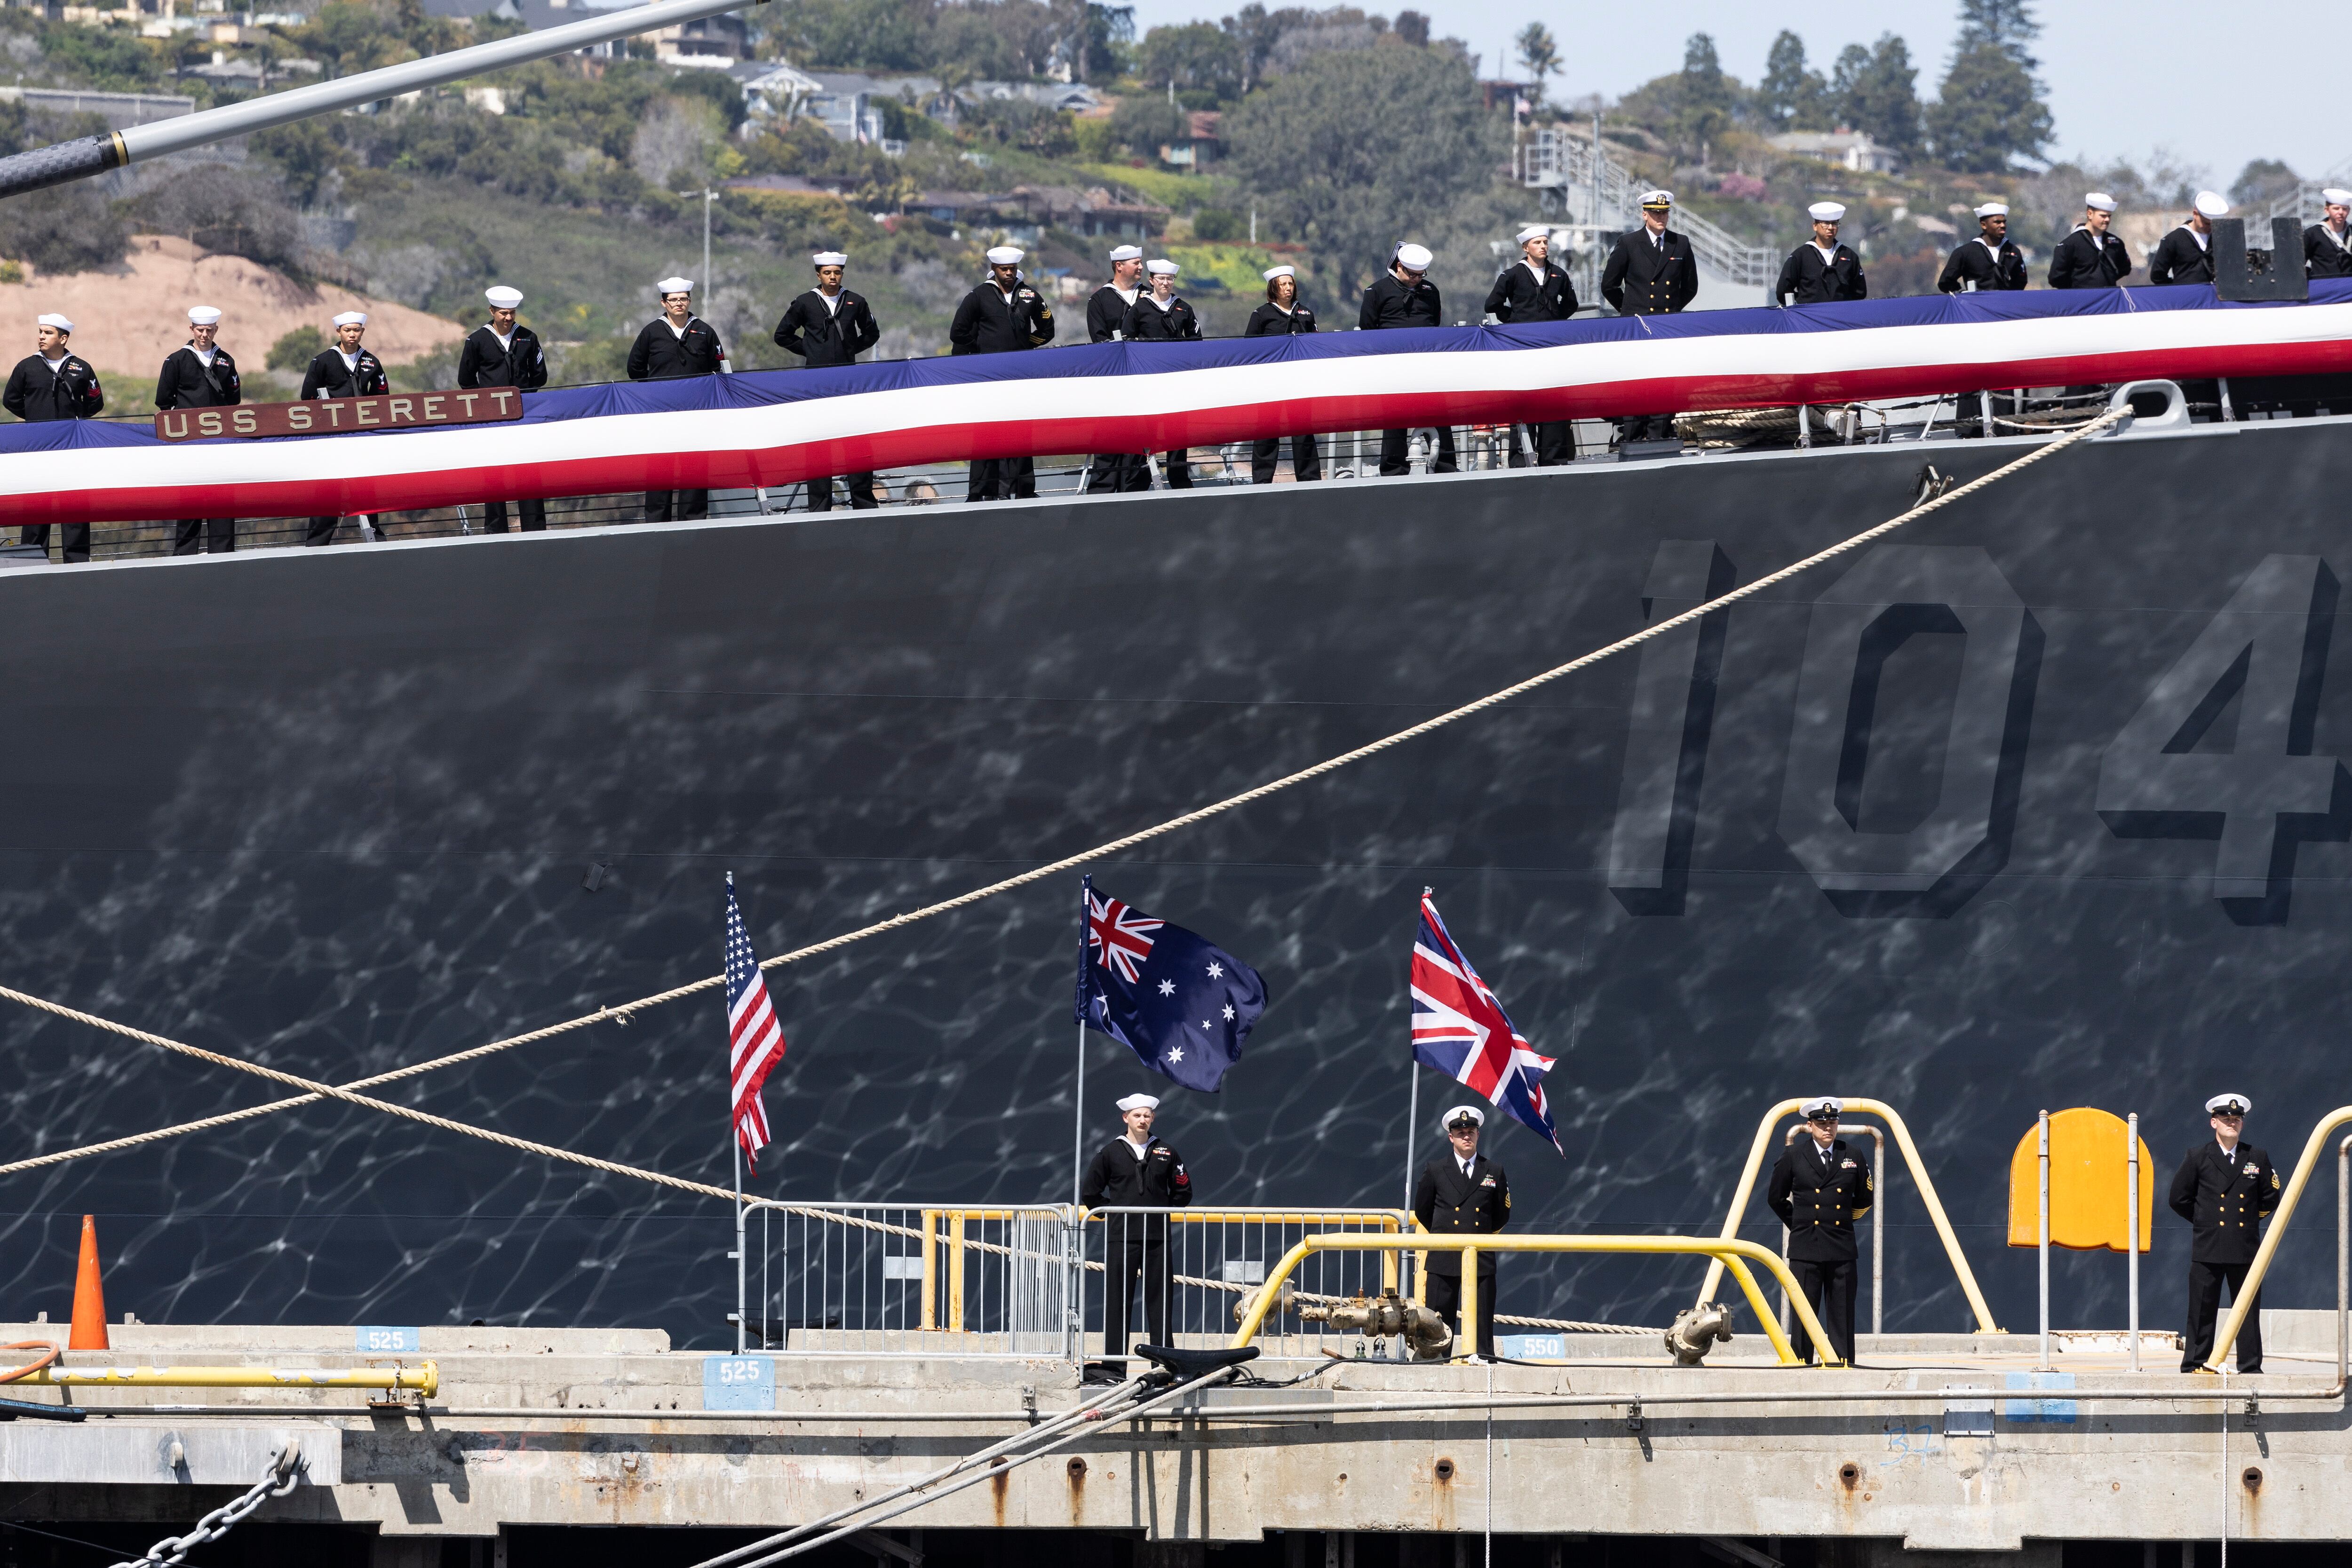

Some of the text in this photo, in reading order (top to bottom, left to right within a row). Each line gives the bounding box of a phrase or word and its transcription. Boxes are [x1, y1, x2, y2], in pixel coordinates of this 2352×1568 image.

[164, 391, 514, 438] USS STERETT
[1608, 539, 2352, 926] 104
[369, 1331, 404, 1349] 525
[1525, 1338, 1558, 1355] 550
[720, 1360, 760, 1383] 525
[1880, 1425, 1945, 1468] 37
